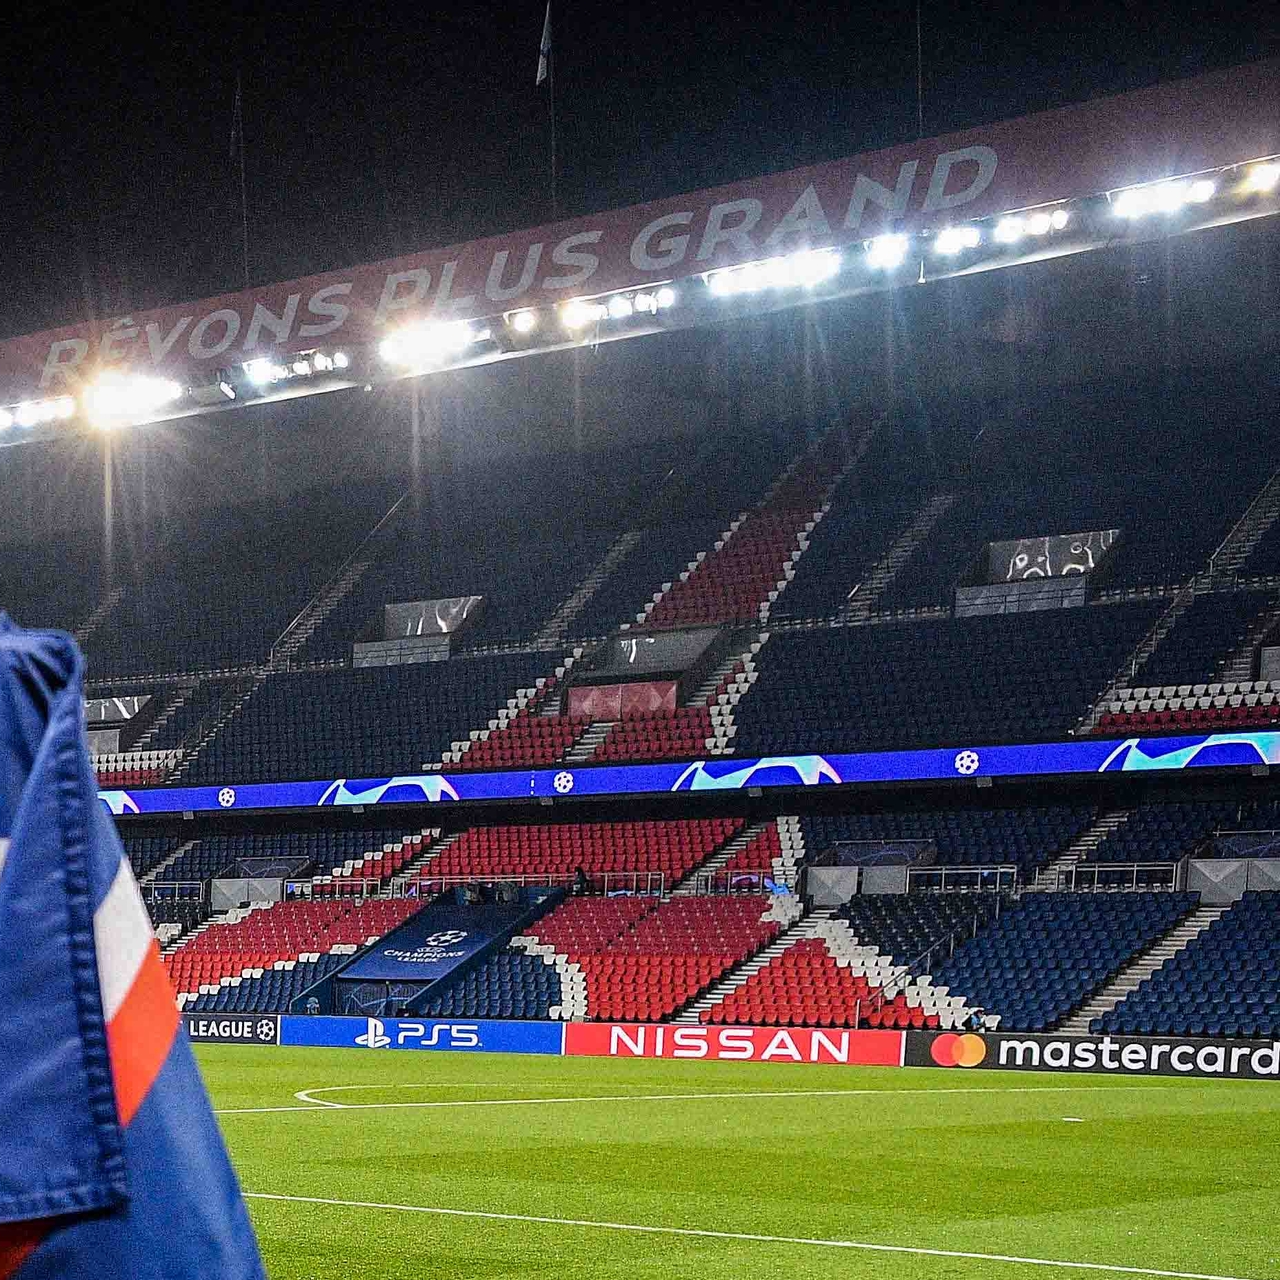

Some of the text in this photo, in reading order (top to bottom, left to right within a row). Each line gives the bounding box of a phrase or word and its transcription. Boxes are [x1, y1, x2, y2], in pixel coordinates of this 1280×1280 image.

[374, 230, 603, 326] PLUS
[629, 145, 999, 271] GRAND
[383, 949, 466, 959] CHAMPIONS
[190, 1020, 253, 1037] LEAGUE
[398, 1023, 479, 1047] PS5
[610, 1026, 850, 1063] NISSAN
[999, 1035, 1280, 1075] mastercard
